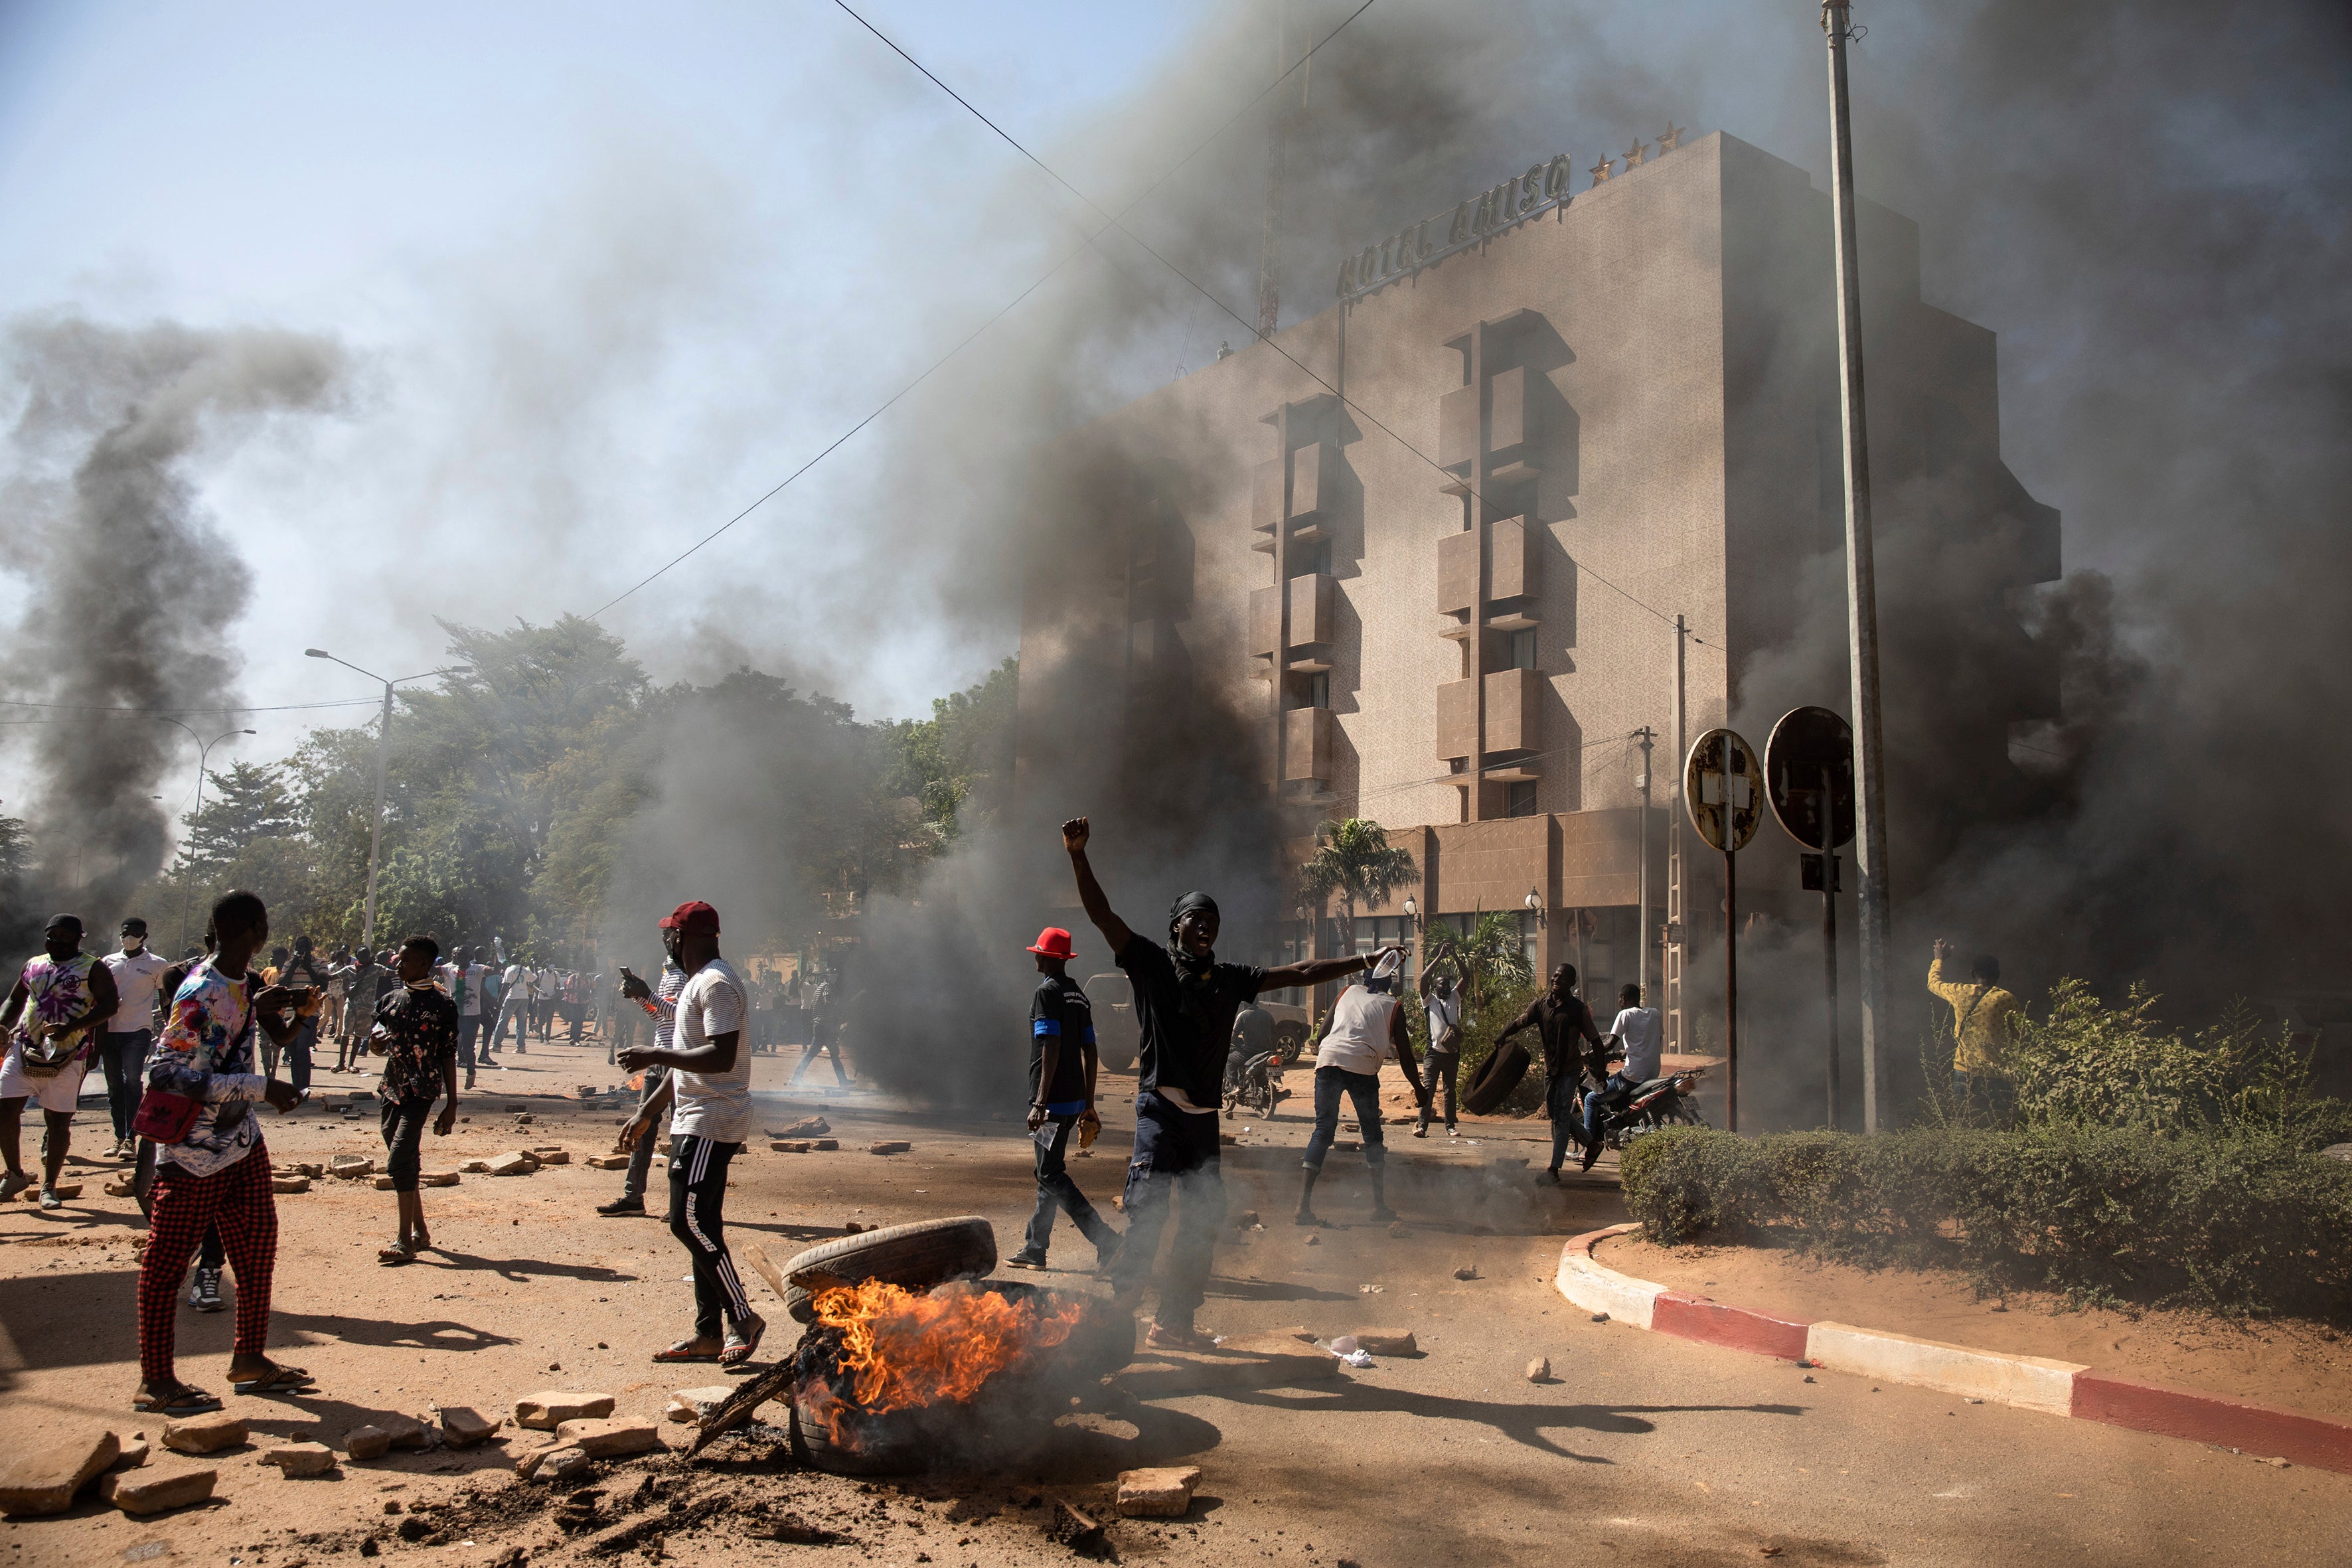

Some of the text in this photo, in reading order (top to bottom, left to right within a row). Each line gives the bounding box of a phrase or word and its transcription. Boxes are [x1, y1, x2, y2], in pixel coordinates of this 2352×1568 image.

[1336, 154, 1567, 298] HOTEL AMISO
[686, 1191, 718, 1252] calabasas
